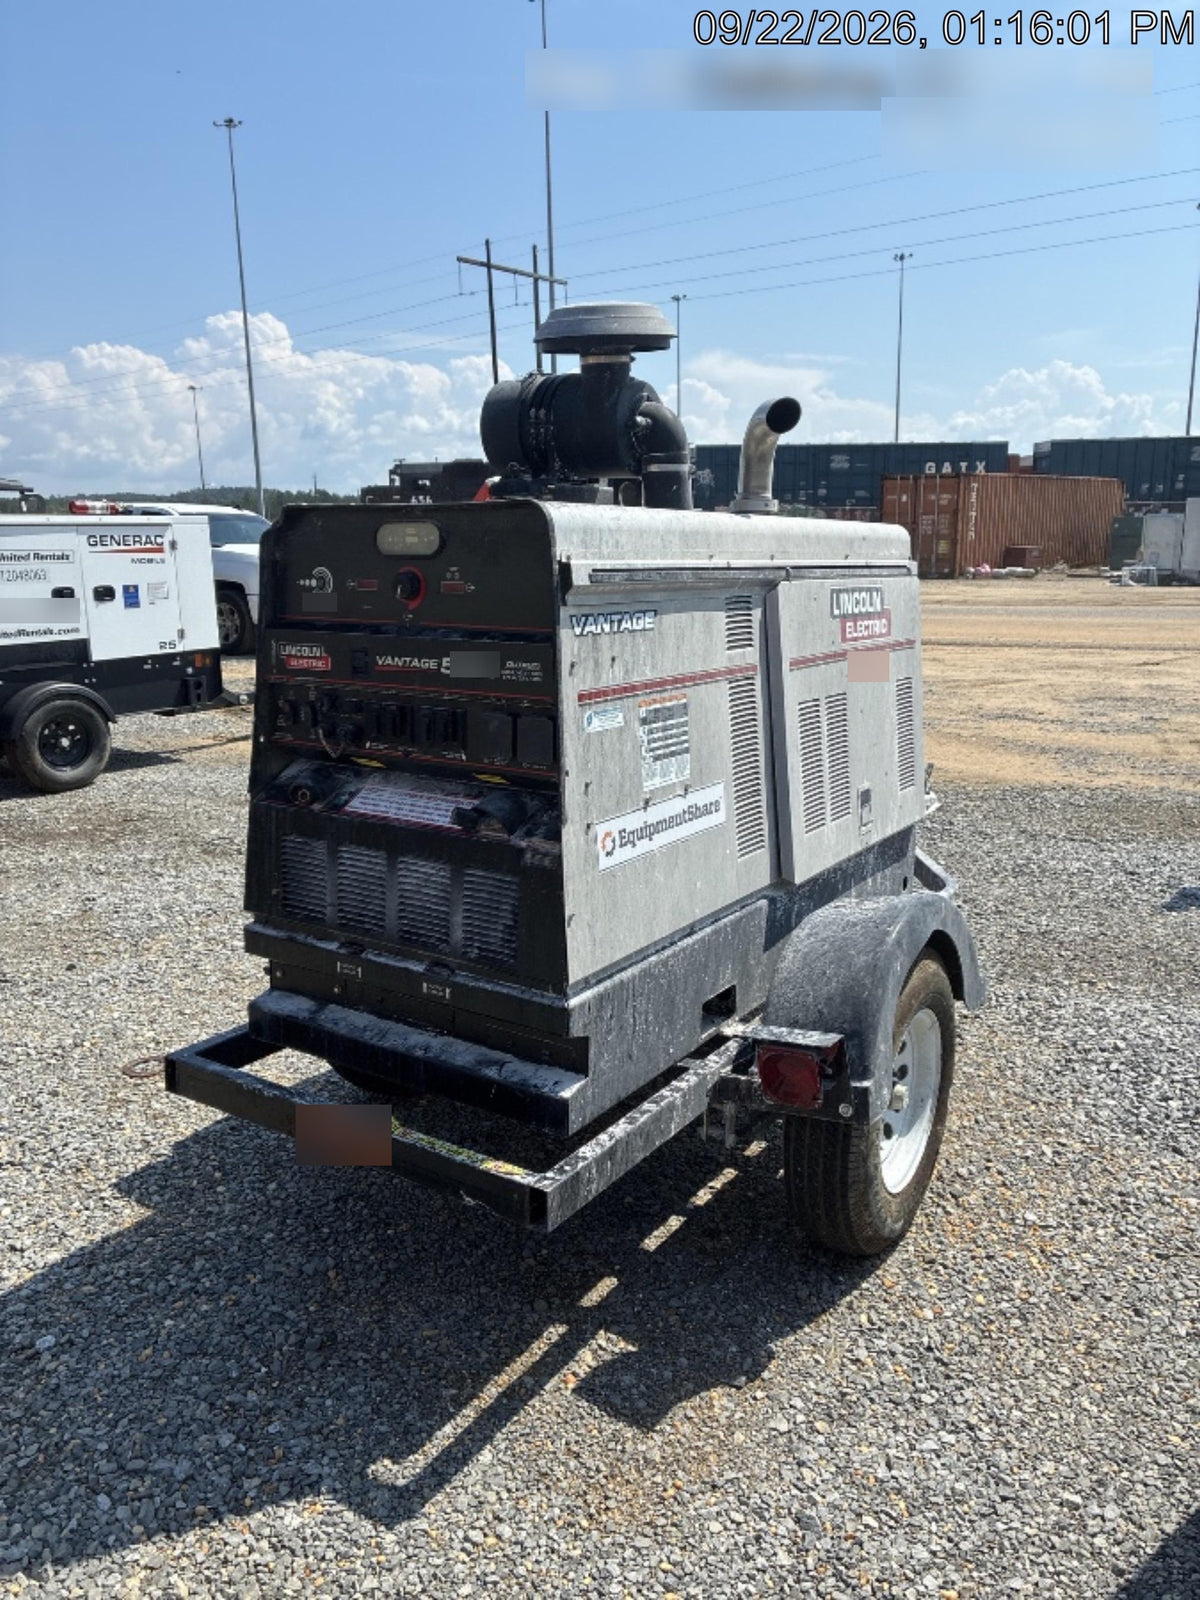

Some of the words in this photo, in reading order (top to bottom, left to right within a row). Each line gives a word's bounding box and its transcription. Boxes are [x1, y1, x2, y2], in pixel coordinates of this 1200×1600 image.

[925, 461, 986, 475] GATX
[86, 534, 164, 547] GENERAC
[32, 551, 70, 561] Rentals
[833, 591, 882, 616] LINCOLN
[569, 605, 657, 637] VANTAGE
[158, 640, 177, 650] 25
[280, 644, 321, 657] LINCOLN
[289, 658, 327, 668] ELECTRIC
[376, 655, 439, 670] VANTAGE
[617, 799, 721, 849] EquipmentShare
